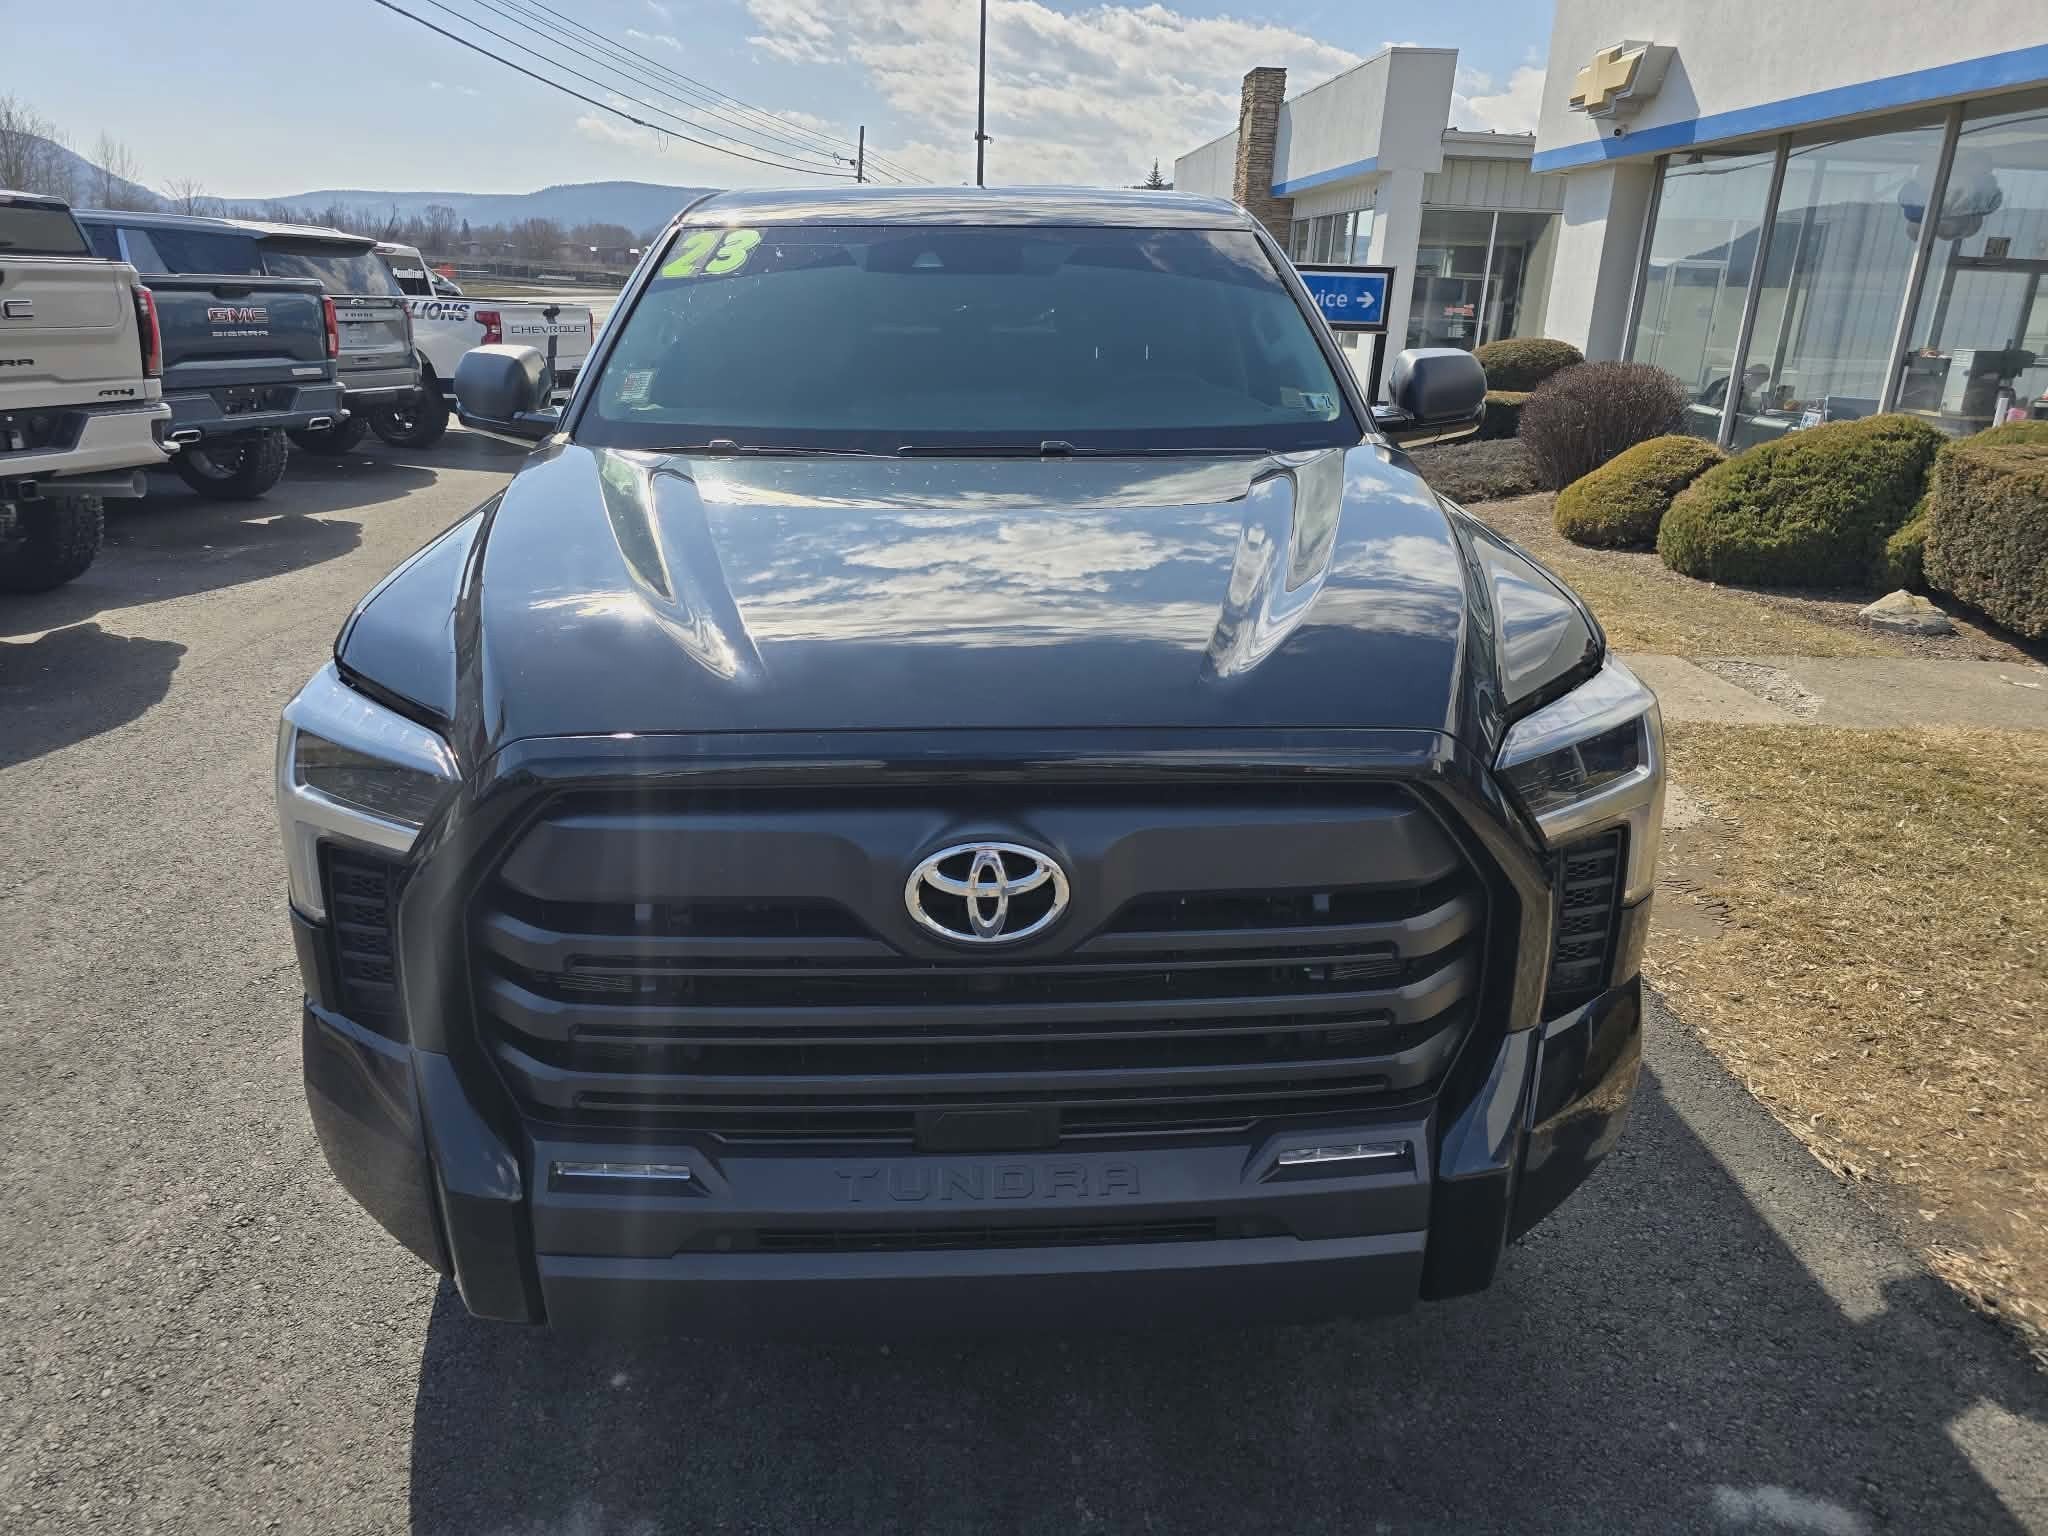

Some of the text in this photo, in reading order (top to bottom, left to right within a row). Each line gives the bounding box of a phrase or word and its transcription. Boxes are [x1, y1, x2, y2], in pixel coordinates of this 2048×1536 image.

[661, 228, 761, 278] 23
[208, 307, 269, 324] GMC
[411, 302, 470, 321] LIONS
[511, 324, 586, 334] CHEVROLET
[834, 1161, 1143, 1202] TUNDRA
